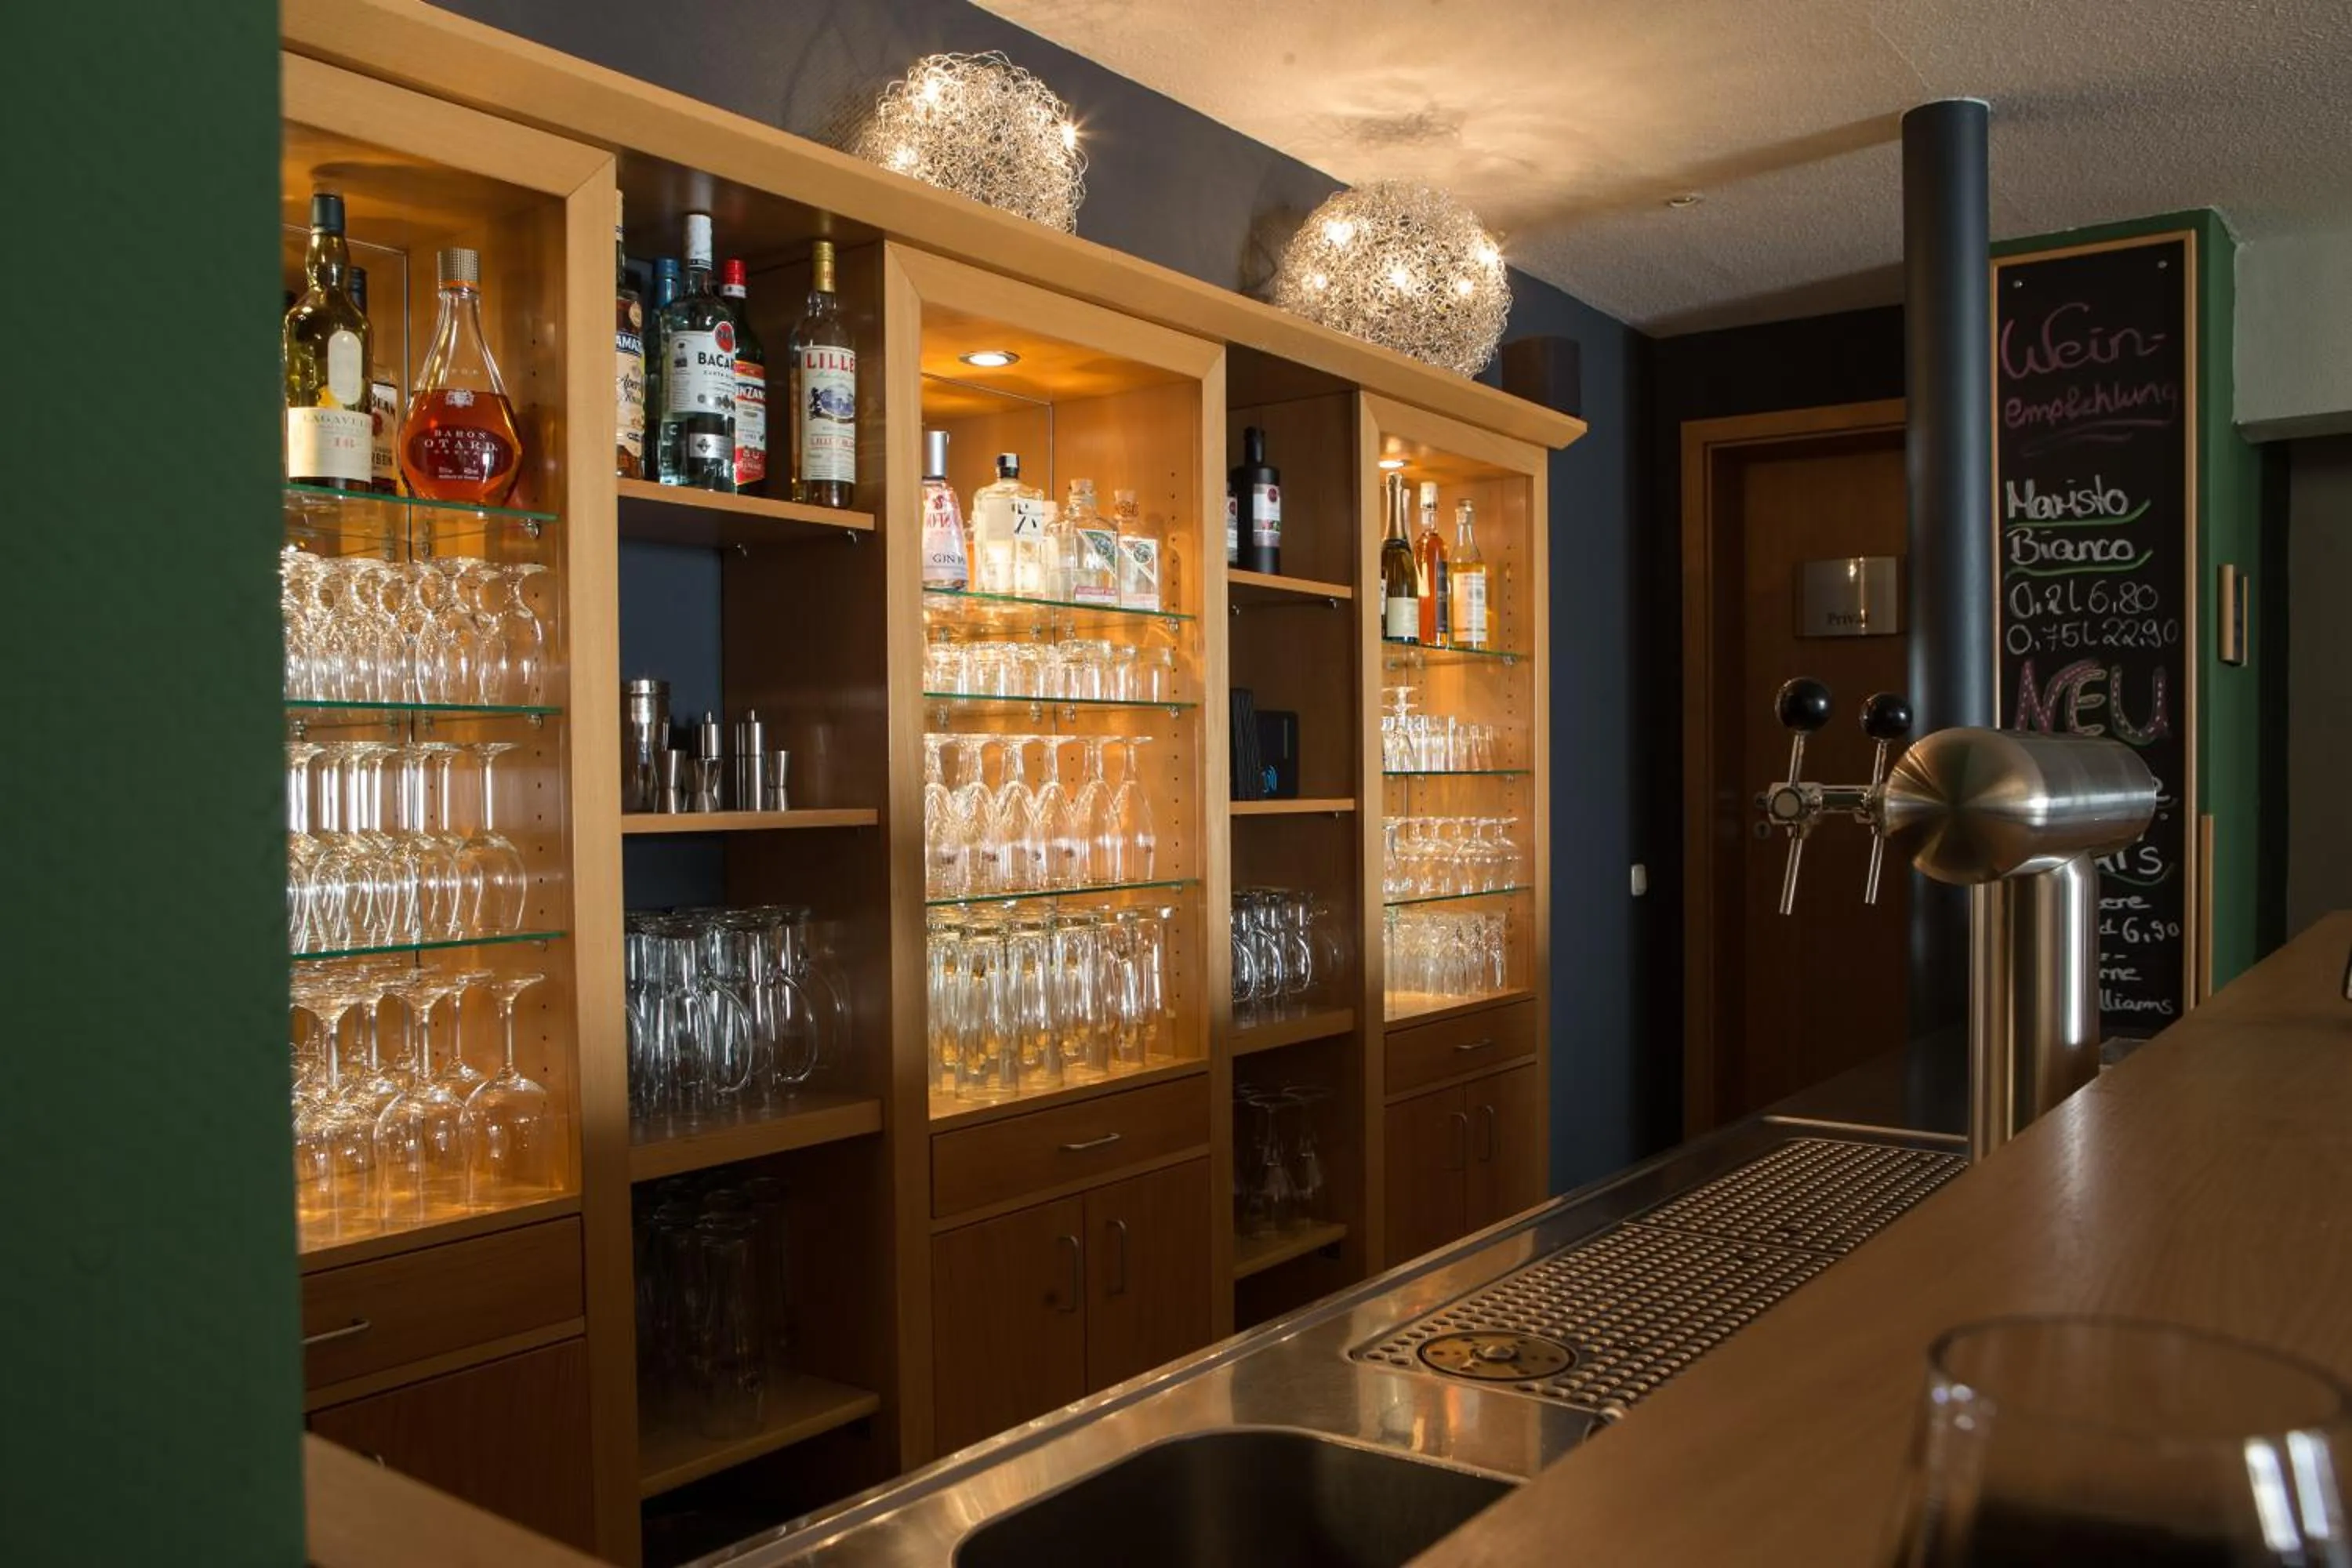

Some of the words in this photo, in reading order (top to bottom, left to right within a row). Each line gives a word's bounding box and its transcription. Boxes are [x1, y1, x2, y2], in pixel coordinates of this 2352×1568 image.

[2000, 303, 2166, 379] Wein-
[434, 429, 486, 439] BARON
[932, 554, 955, 564] GIN
[2006, 527, 2136, 566] Bianco
[2088, 579, 2159, 615] 6,80
[2101, 617, 2180, 648] 22,90
[2014, 659, 2169, 746] NEU
[2122, 916, 2180, 944] 6,90
